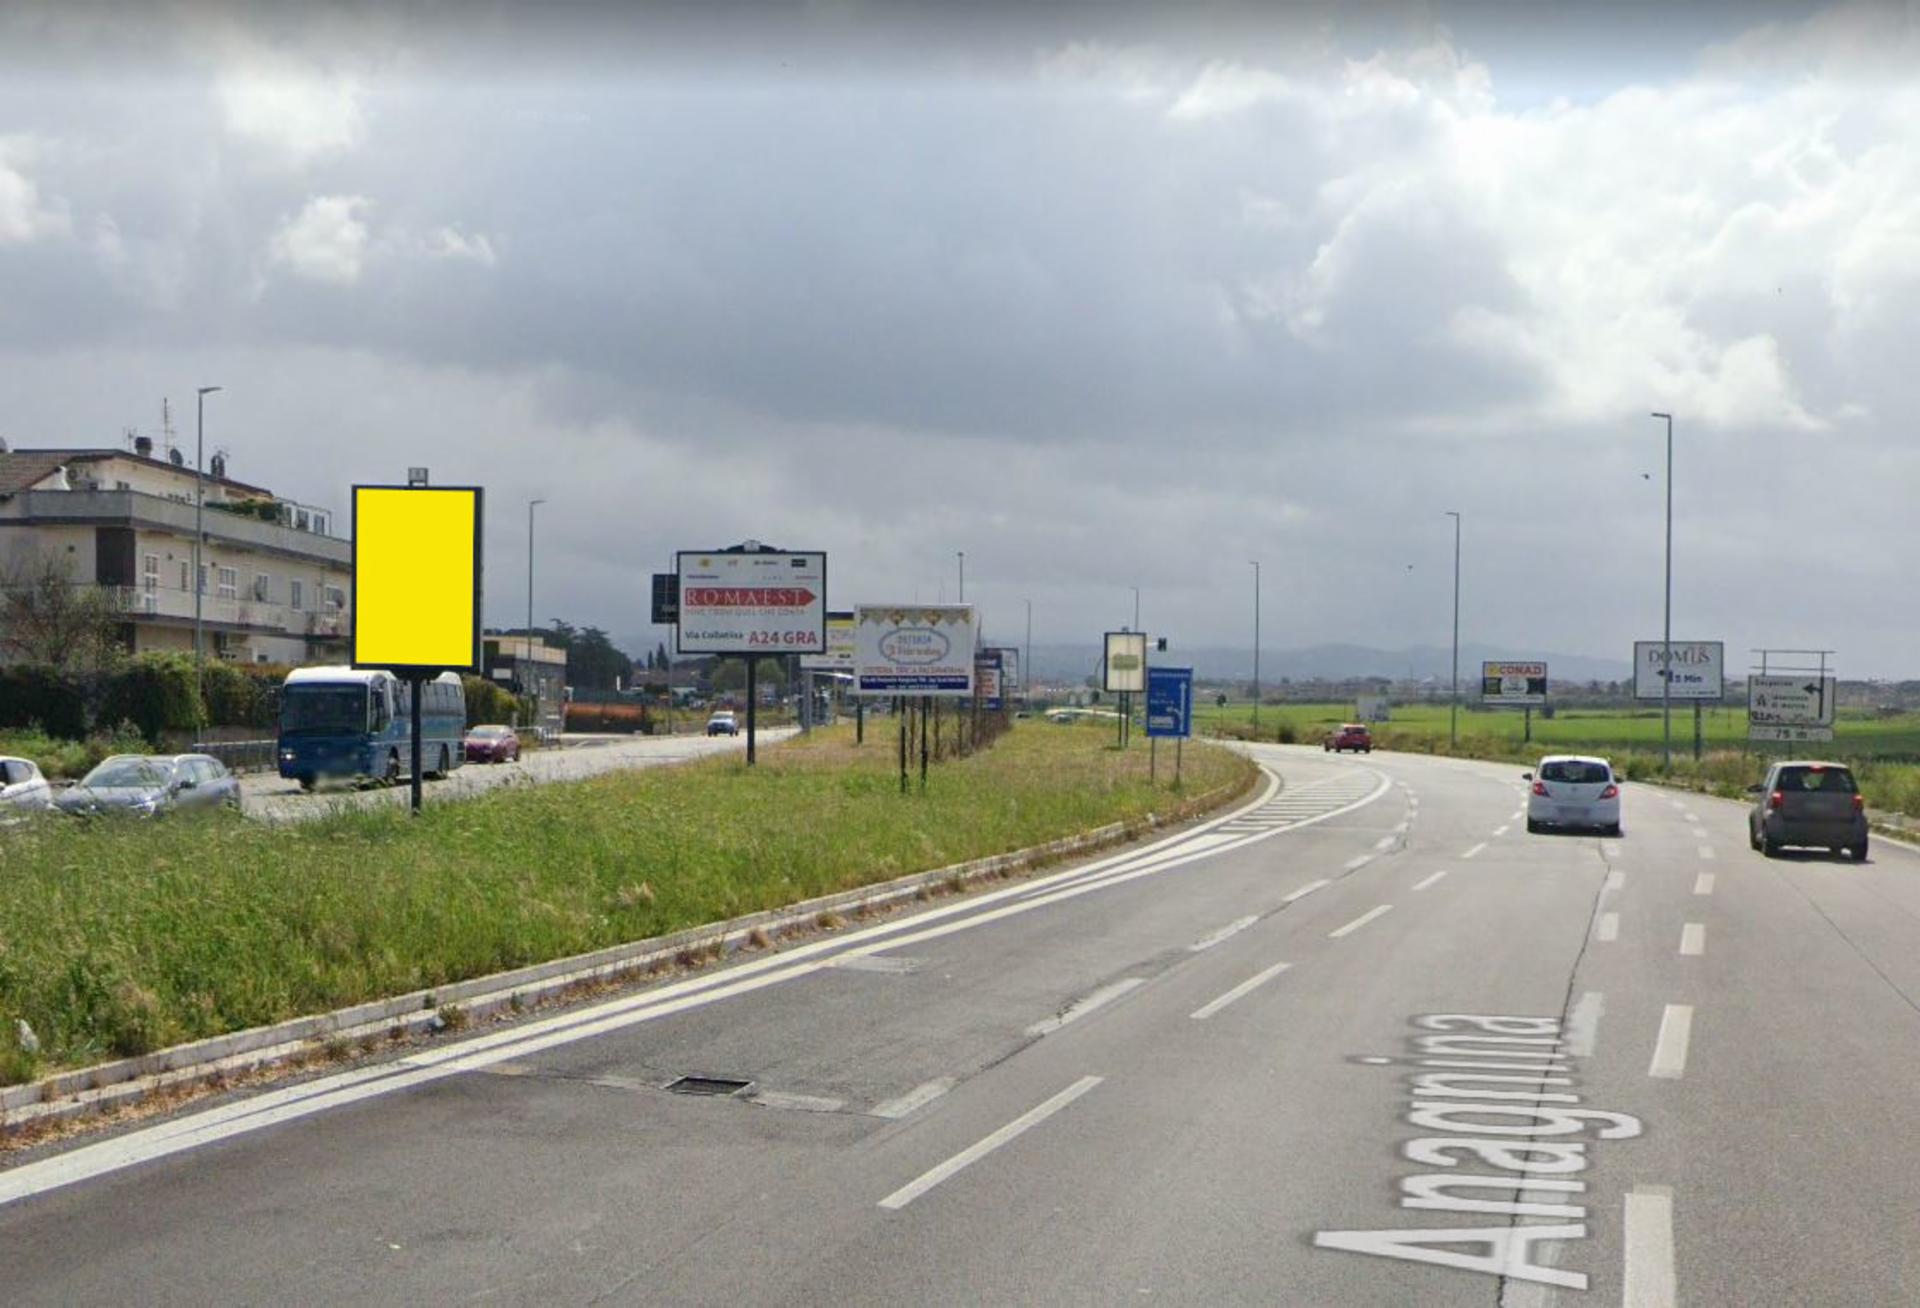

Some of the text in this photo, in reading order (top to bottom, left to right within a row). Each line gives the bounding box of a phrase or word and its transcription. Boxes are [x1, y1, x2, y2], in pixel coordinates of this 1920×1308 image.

[685, 631, 817, 645] Via Collatina A24 GRA
[1499, 665, 1542, 675] CONAD
[1684, 675, 1703, 683] Min
[1314, 1014, 1641, 1290] Anagnina
